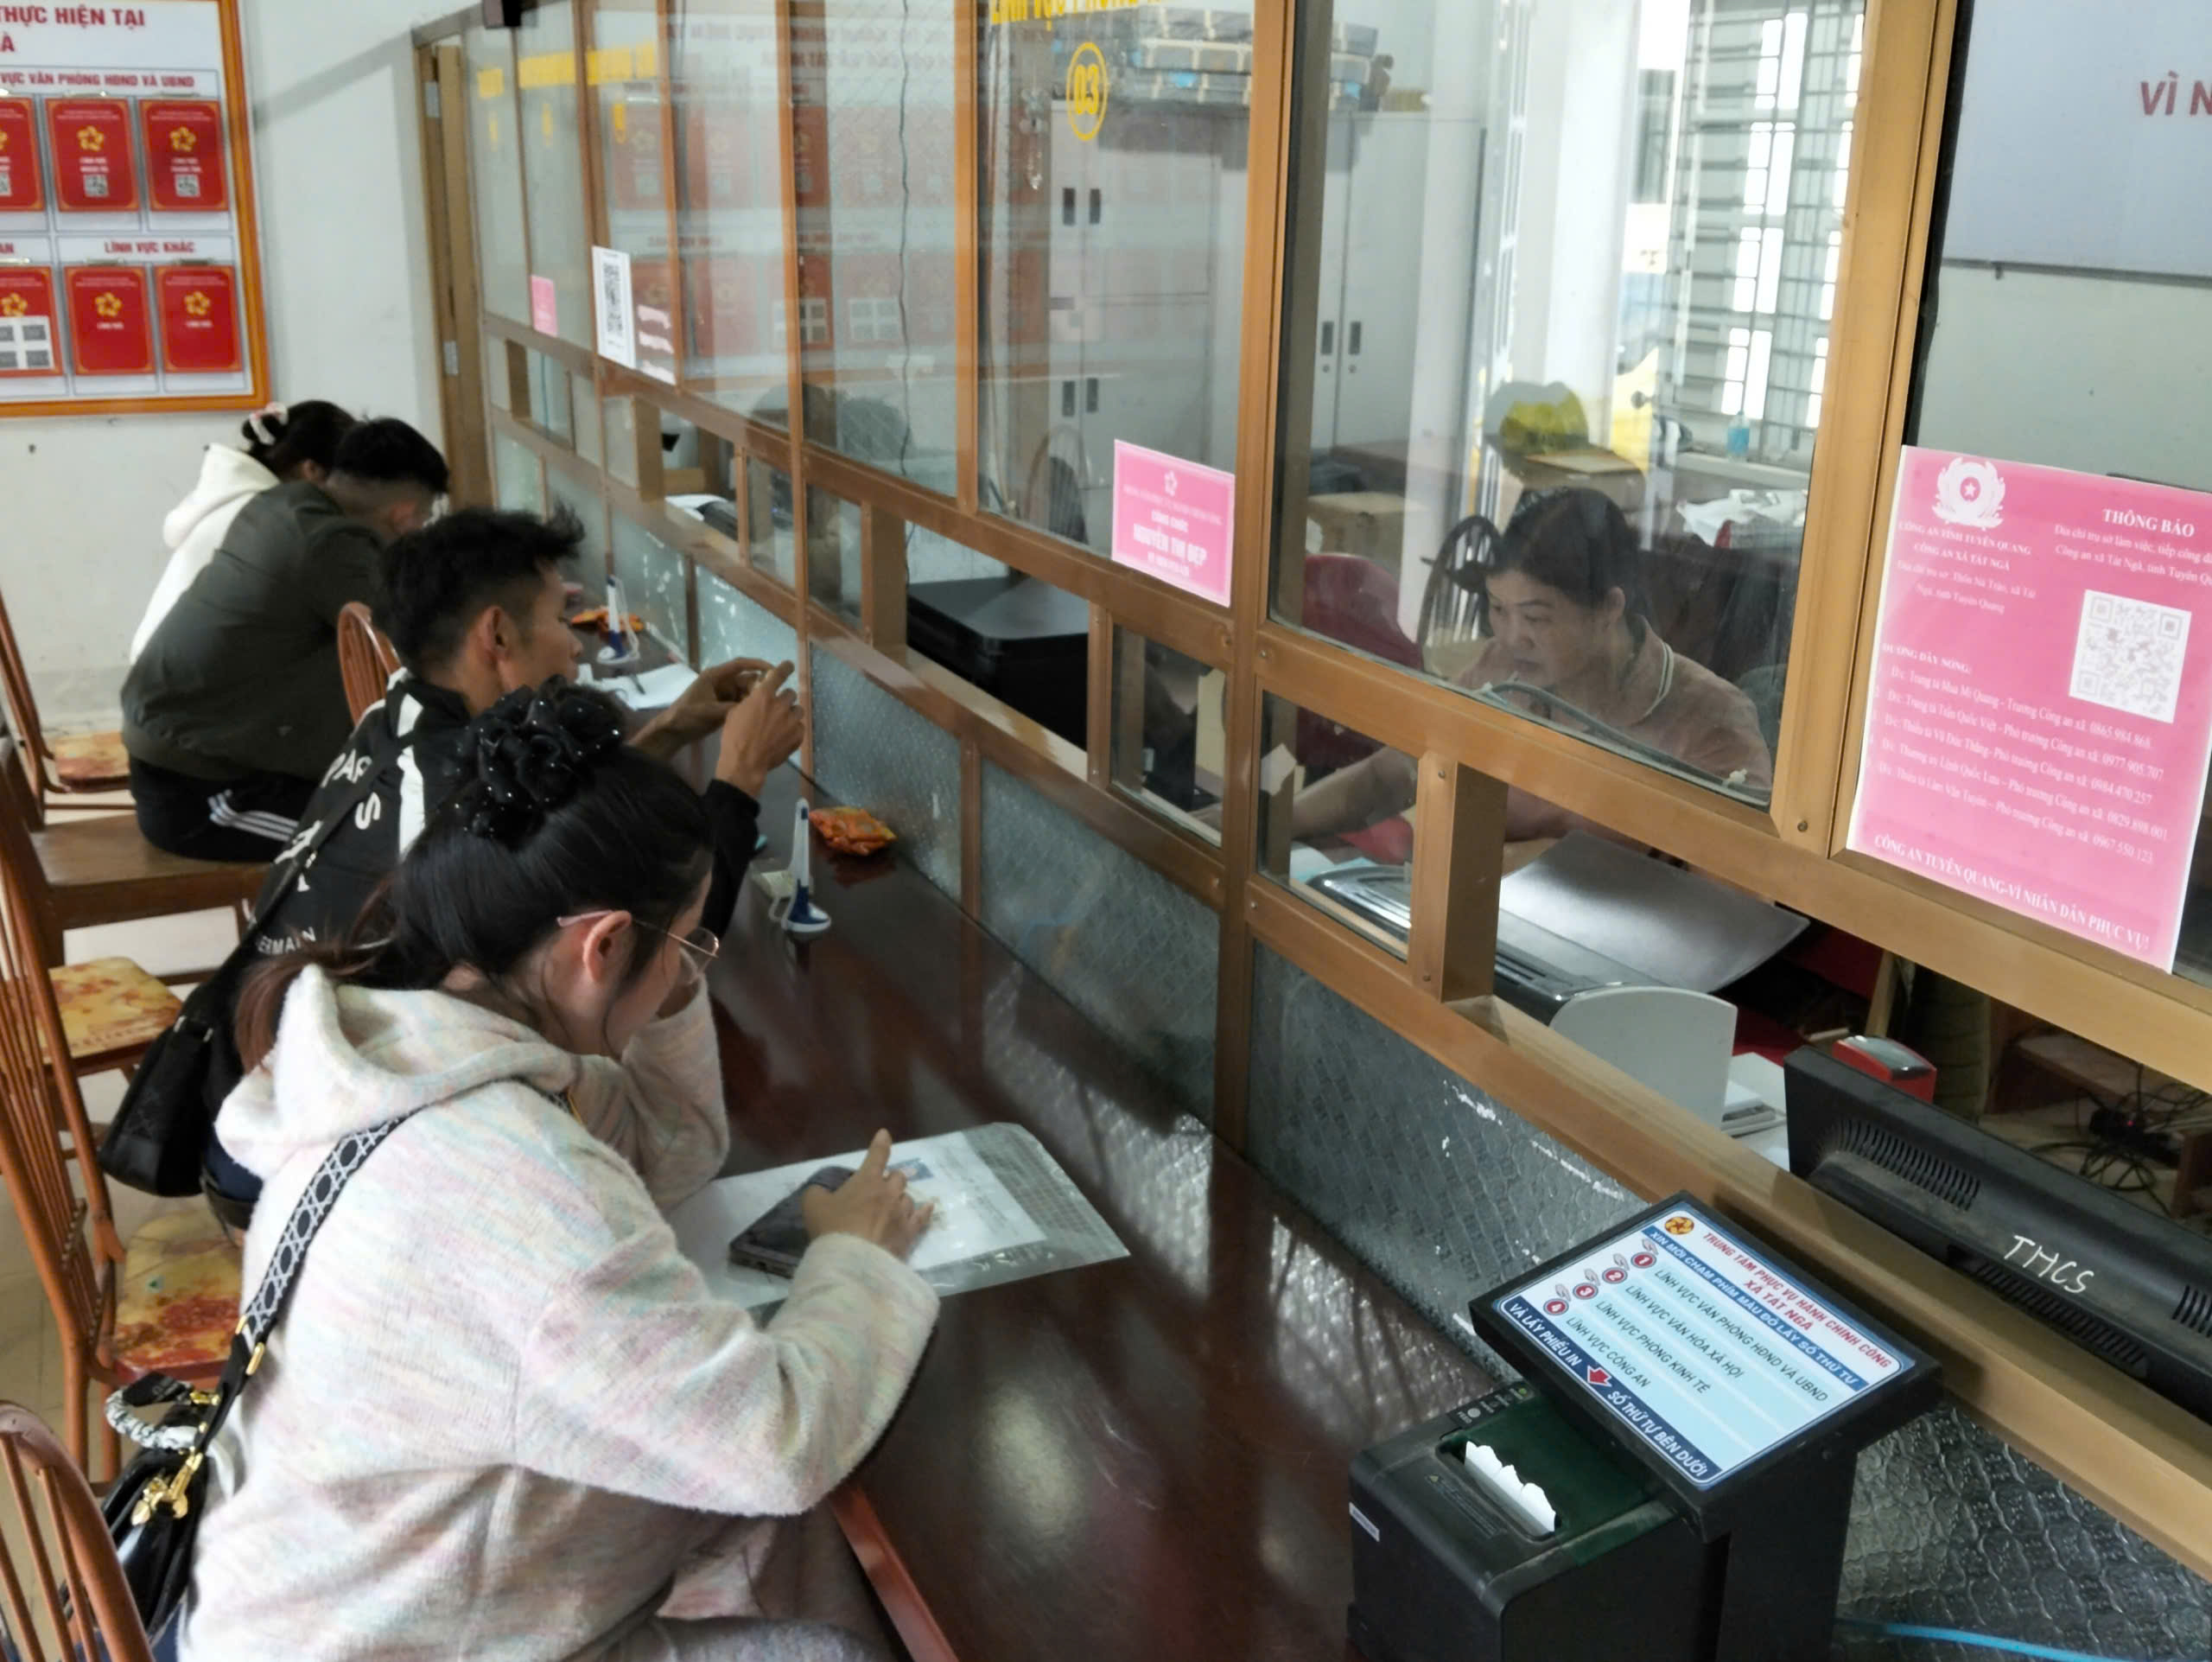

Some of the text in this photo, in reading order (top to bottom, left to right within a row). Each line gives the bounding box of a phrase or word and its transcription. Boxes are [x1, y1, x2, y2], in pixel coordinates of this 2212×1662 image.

[54, 4, 106, 29] HIỆN
[111, 8, 145, 30] TẠI
[1074, 63, 1099, 116] 03
[2140, 69, 2178, 116] VÌ
[2101, 508, 2196, 537] THÔNG BÁO
[1874, 833, 1905, 857] CÔNG
[1907, 846, 1923, 863] AN
[1925, 853, 1963, 878] TUYÊN
[2024, 889, 2058, 914] NHÂN
[2059, 902, 2086, 926] DÂN
[2088, 914, 2125, 940] PHỤC
[1649, 1232, 1669, 1245] XIN
[1668, 1244, 1687, 1259] MỜI
[1712, 1277, 1739, 1298] PHÍM
[1738, 1294, 1763, 1315] MÀU
[1703, 1232, 1735, 1258] TRUNG
[1733, 1253, 1758, 1272] TÂM
[1752, 1270, 1784, 1292] PHỤC
[1796, 1298, 1827, 1322] HÀNH
[1825, 1320, 1862, 1347] CHÍNH
[1858, 1344, 1892, 1369] CÔNG
[1744, 1279, 1764, 1295] XÃ
[1509, 1302, 1584, 1367] VÀ LẤY PHIẾU IN
[1566, 1315, 1652, 1389] LĨNH VỰC CÔNG AN
[1595, 1300, 1713, 1395] LĨNH VỰC PHÒNG KINH TẾ
[1624, 1284, 1650, 1305] LĨNH
[1646, 1300, 1671, 1321] VỰC
[1667, 1316, 1691, 1337] VĂN
[1706, 1348, 1726, 1366] XÃ
[1721, 1360, 1745, 1379] HỘI
[1654, 1268, 1829, 1403] LĨNH VỰC VĂN PHÒNG HĐND VÀ UBND
[1607, 1390, 1709, 1478] SỐ THỨ TỰ BÊN DƯỚI
